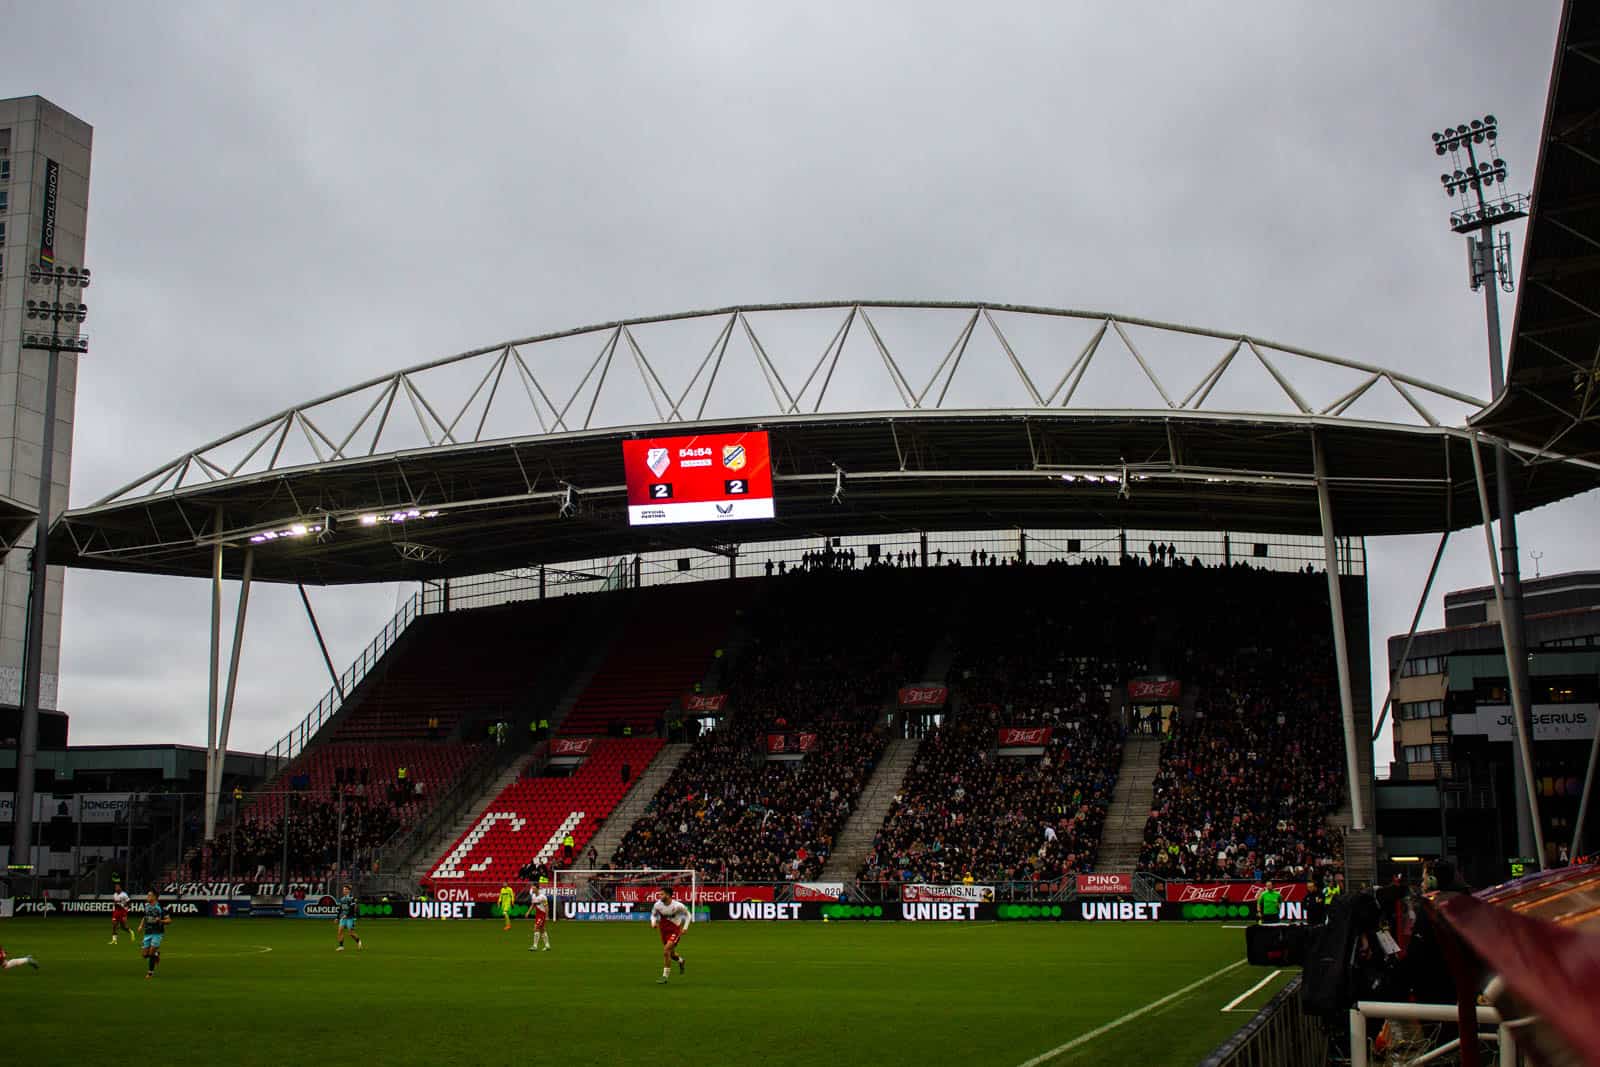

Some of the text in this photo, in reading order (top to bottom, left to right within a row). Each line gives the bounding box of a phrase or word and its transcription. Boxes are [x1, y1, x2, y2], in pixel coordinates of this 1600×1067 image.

[45, 165, 57, 247] CONCLUSION
[679, 447, 712, 457] 54:54
[654, 484, 668, 498] 2
[730, 480, 743, 493] 2
[1087, 875, 1120, 885] PINO
[824, 887, 841, 896] 020
[16, 902, 56, 912] STIGA
[163, 903, 199, 913] STIGA
[409, 902, 475, 918] UNIBET
[564, 902, 634, 918] UNIBET
[728, 903, 802, 919] UNIBET
[902, 903, 979, 920] UNIBET
[1082, 902, 1162, 919] UNIBET
